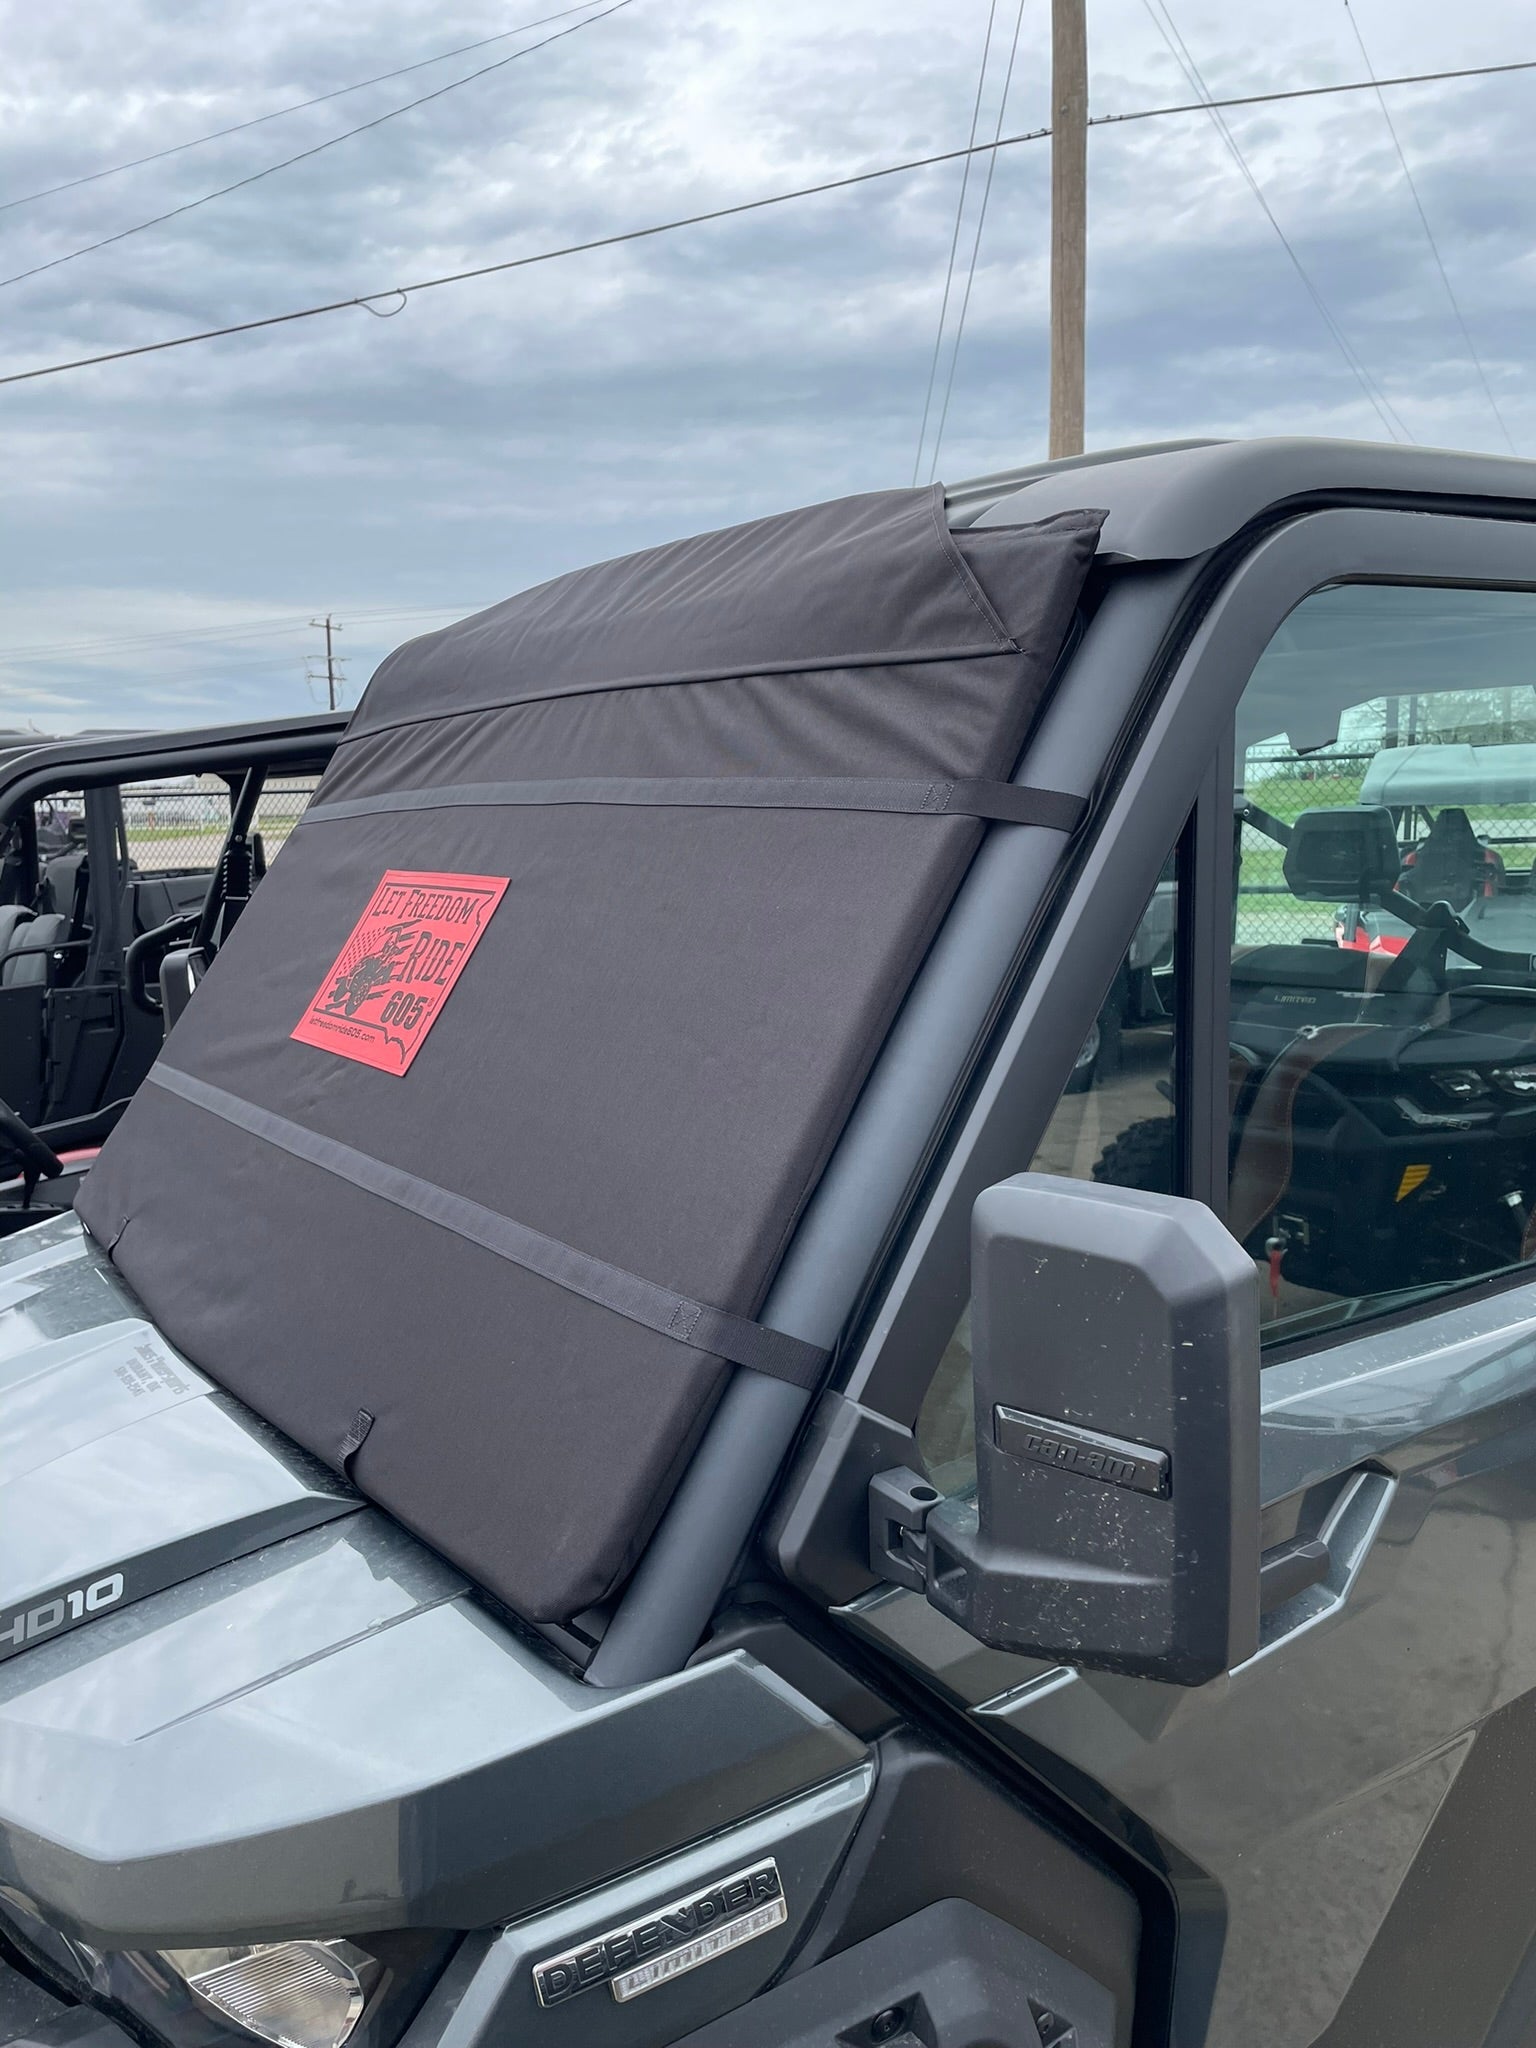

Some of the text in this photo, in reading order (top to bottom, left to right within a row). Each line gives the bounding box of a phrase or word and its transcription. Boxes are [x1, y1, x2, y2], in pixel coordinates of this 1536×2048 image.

[372, 887, 480, 925] LET FREEDOM
[380, 991, 430, 1031] 605
[1026, 1434, 1137, 1481] can-am
[542, 1866, 780, 2000] DEFENDER
[626, 1907, 776, 1991] LIMITED
